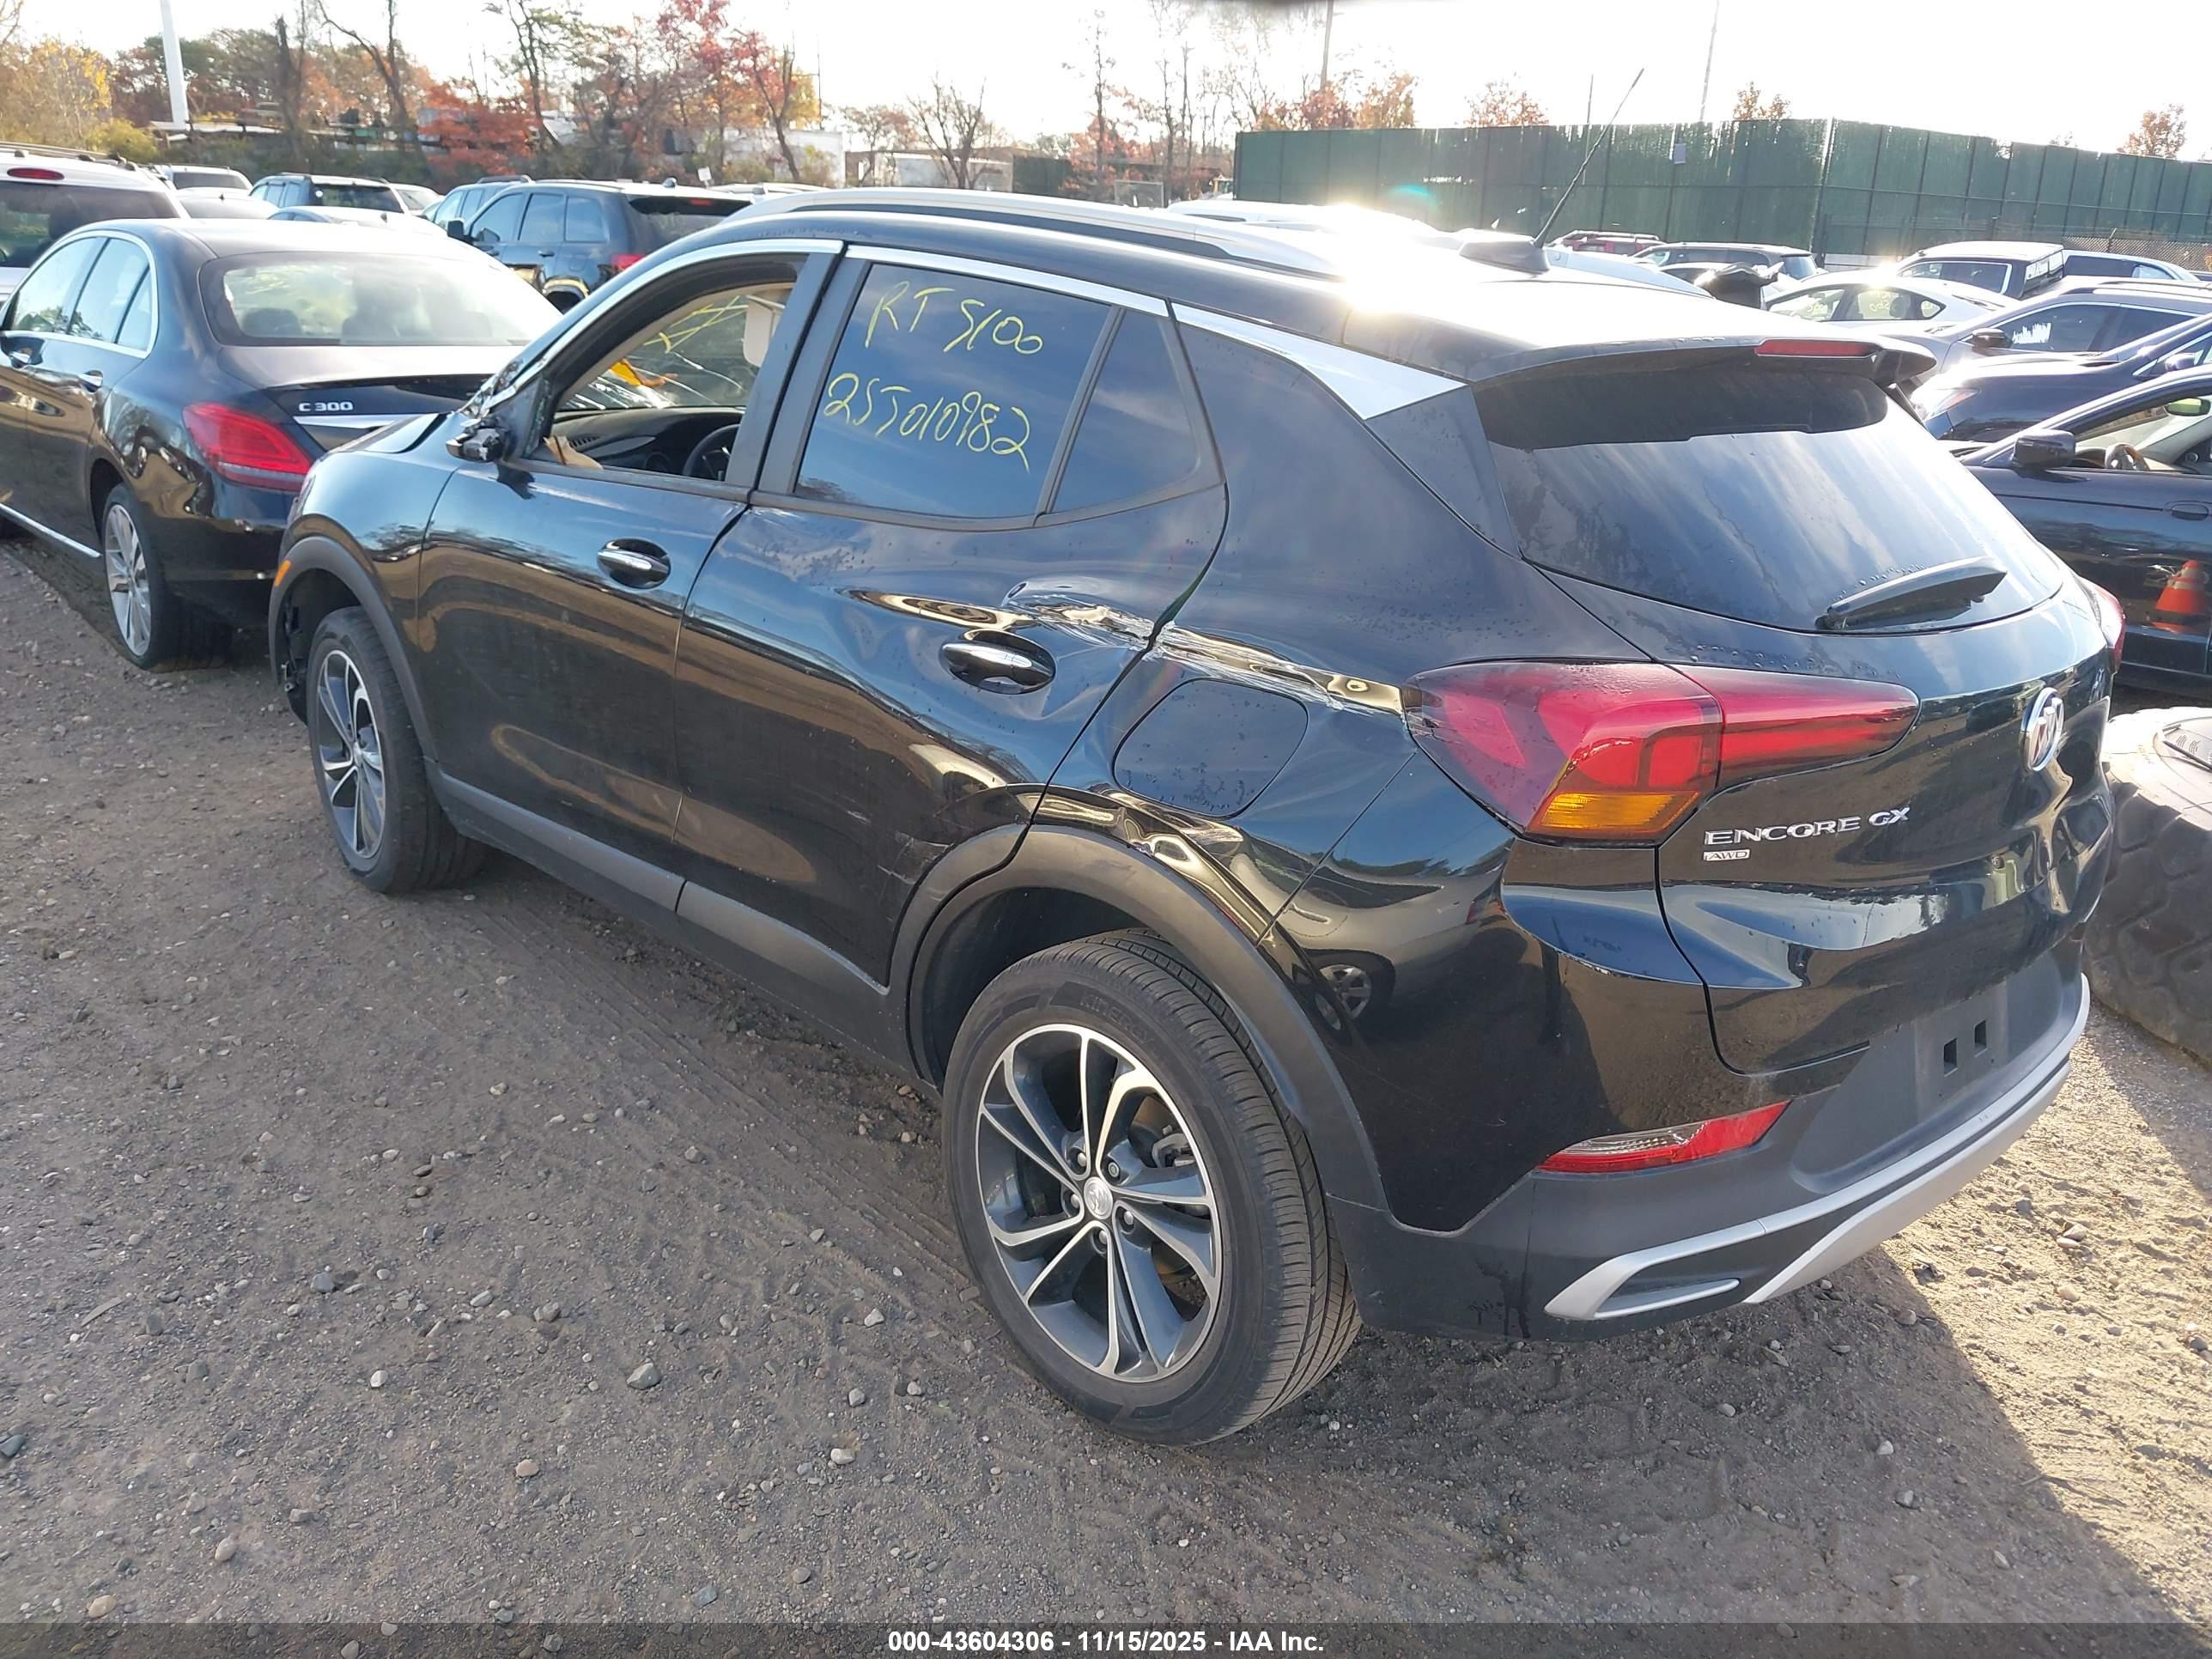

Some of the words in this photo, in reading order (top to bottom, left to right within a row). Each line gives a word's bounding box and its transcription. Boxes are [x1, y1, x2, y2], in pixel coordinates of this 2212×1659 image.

[865, 282, 955, 348] RT
[299, 403, 311, 411] C
[314, 401, 353, 411] 300
[824, 373, 1030, 471] 255010982
[1705, 817, 1861, 845] ENCORE
[1868, 807, 1911, 826] GX
[1703, 849, 1749, 861] AWD
